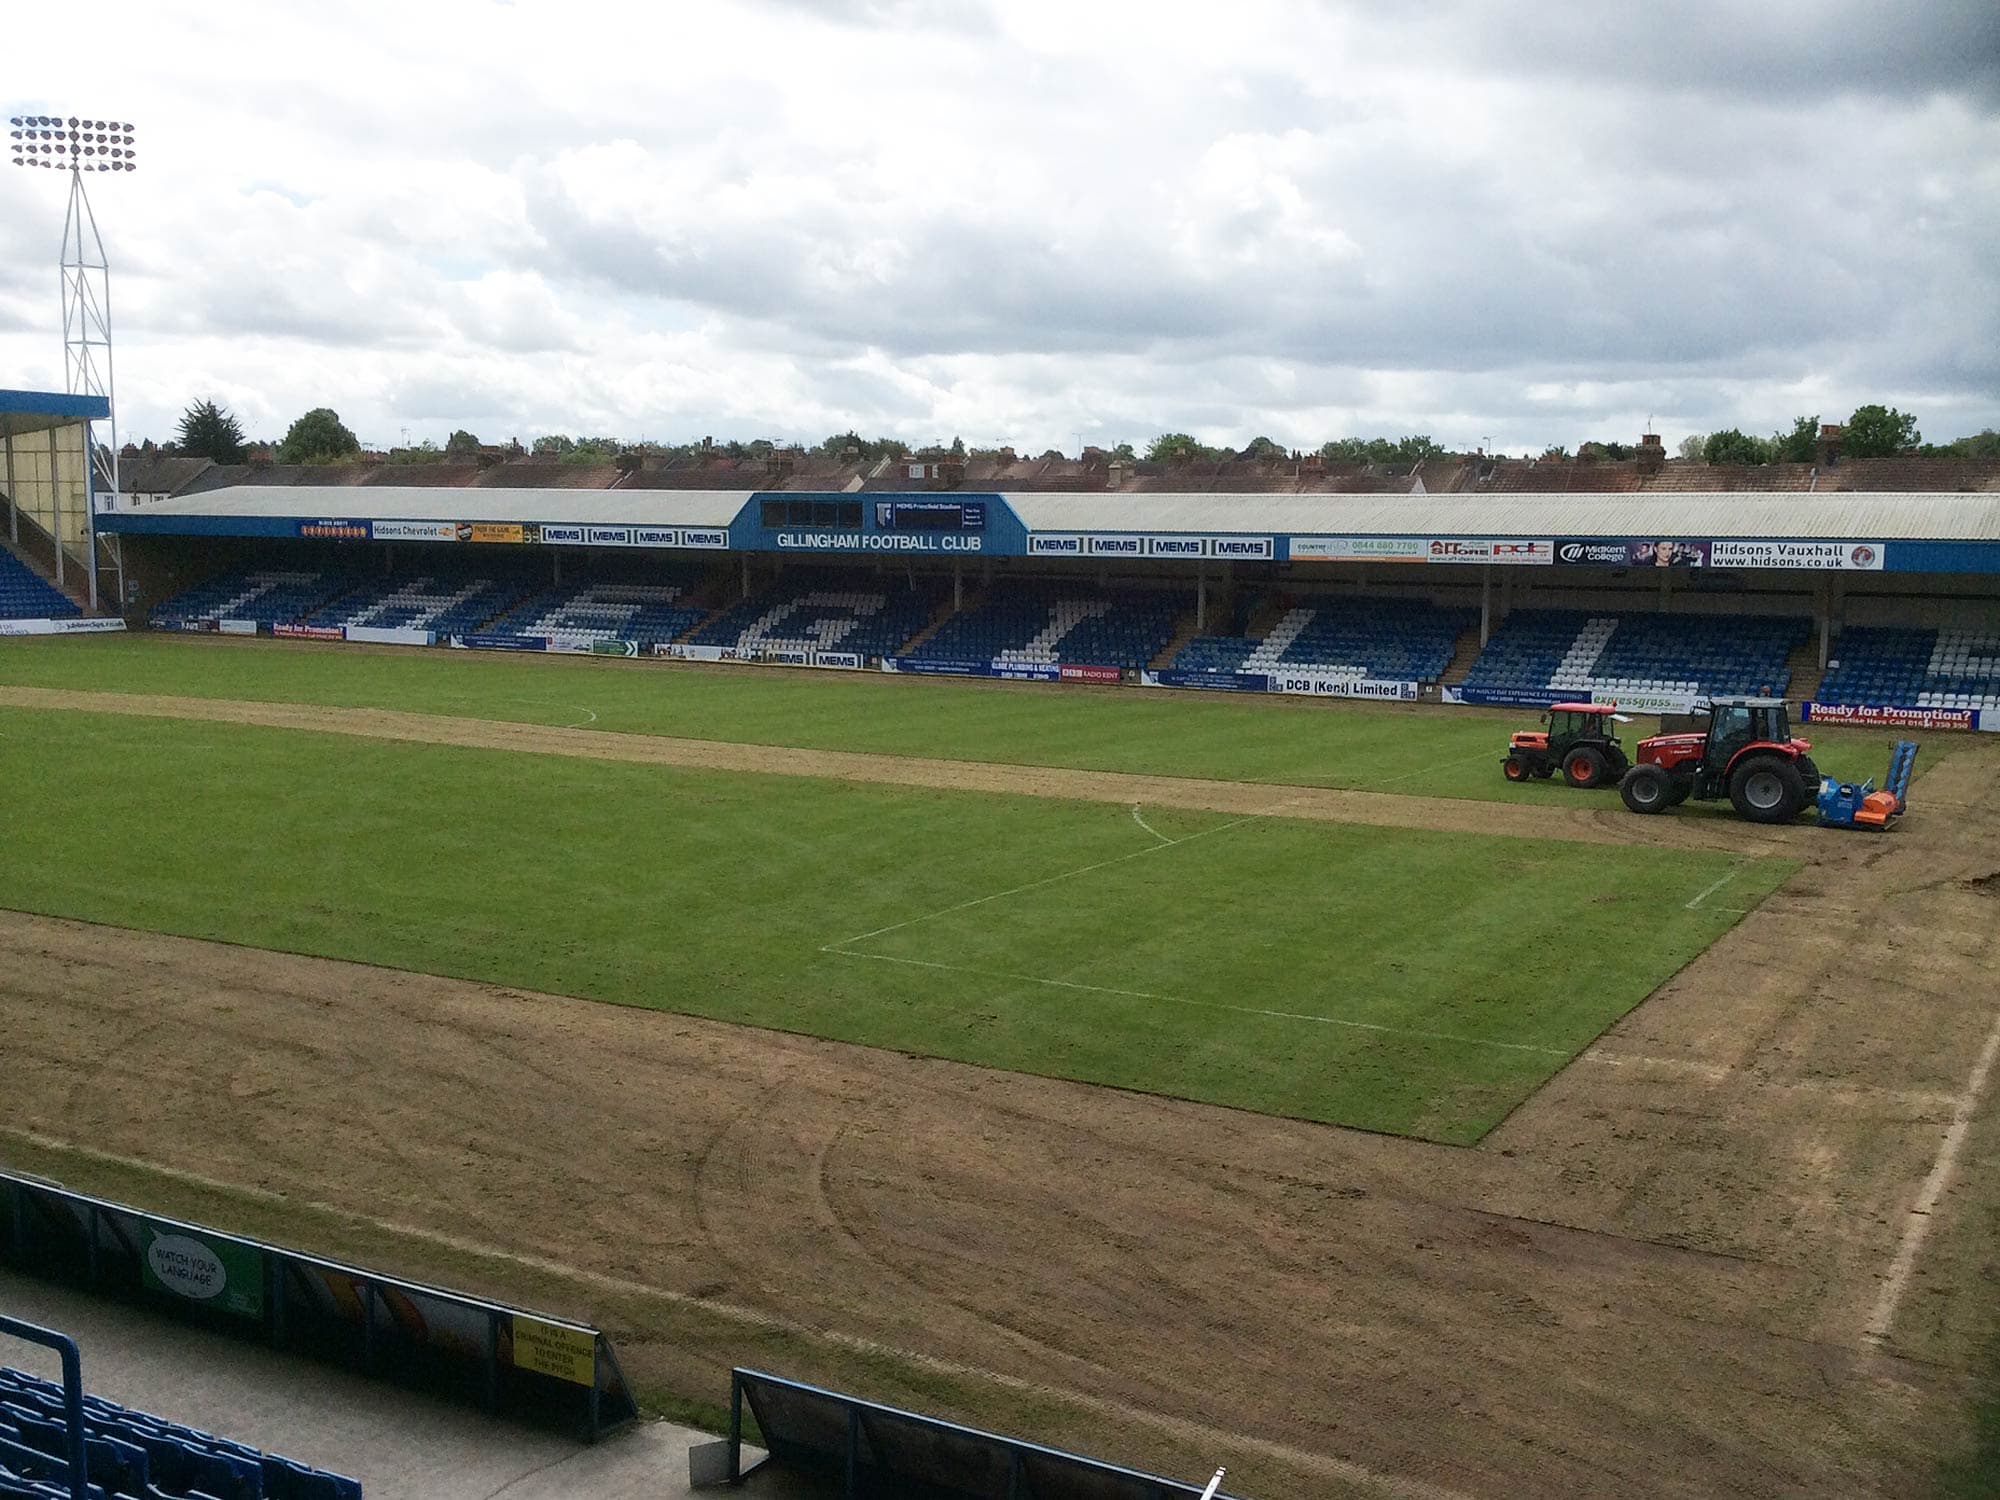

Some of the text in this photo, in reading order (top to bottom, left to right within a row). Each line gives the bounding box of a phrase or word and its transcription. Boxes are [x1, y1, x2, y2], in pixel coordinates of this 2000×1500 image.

[374, 525, 402, 535] Hidsons
[402, 525, 438, 537] Chevrolet
[547, 529, 580, 541] MEMS
[593, 531, 626, 542] MEMS
[639, 532, 673, 543] MEMS
[687, 533, 722, 544] MEMS
[777, 533, 982, 550] GILLINGHAM FOOTBALL CLUB
[1035, 539, 1078, 550] MEMS
[1095, 540, 1138, 551] MEMS
[1155, 541, 1200, 552] MEMS
[1218, 542, 1264, 554] MEMS
[1585, 545, 1627, 554] MidKent
[1713, 543, 1844, 557] Hidsons Vauxhall
[1587, 553, 1624, 562] College
[1713, 556, 1843, 568] www.hidsons.co.uk
[769, 653, 804, 664] MEMS
[819, 655, 855, 666] MEMS
[1083, 670, 1102, 678] RADIO
[1286, 679, 1398, 696] DCB (Kent) Limited
[1809, 702, 1972, 722] Ready for Promotion?
[1823, 716, 1864, 724] Advertise
[156, 1248, 217, 1274] WATCH YOUR
[161, 1264, 213, 1287] LANGUAGE
[546, 1350, 574, 1365] ENTER
